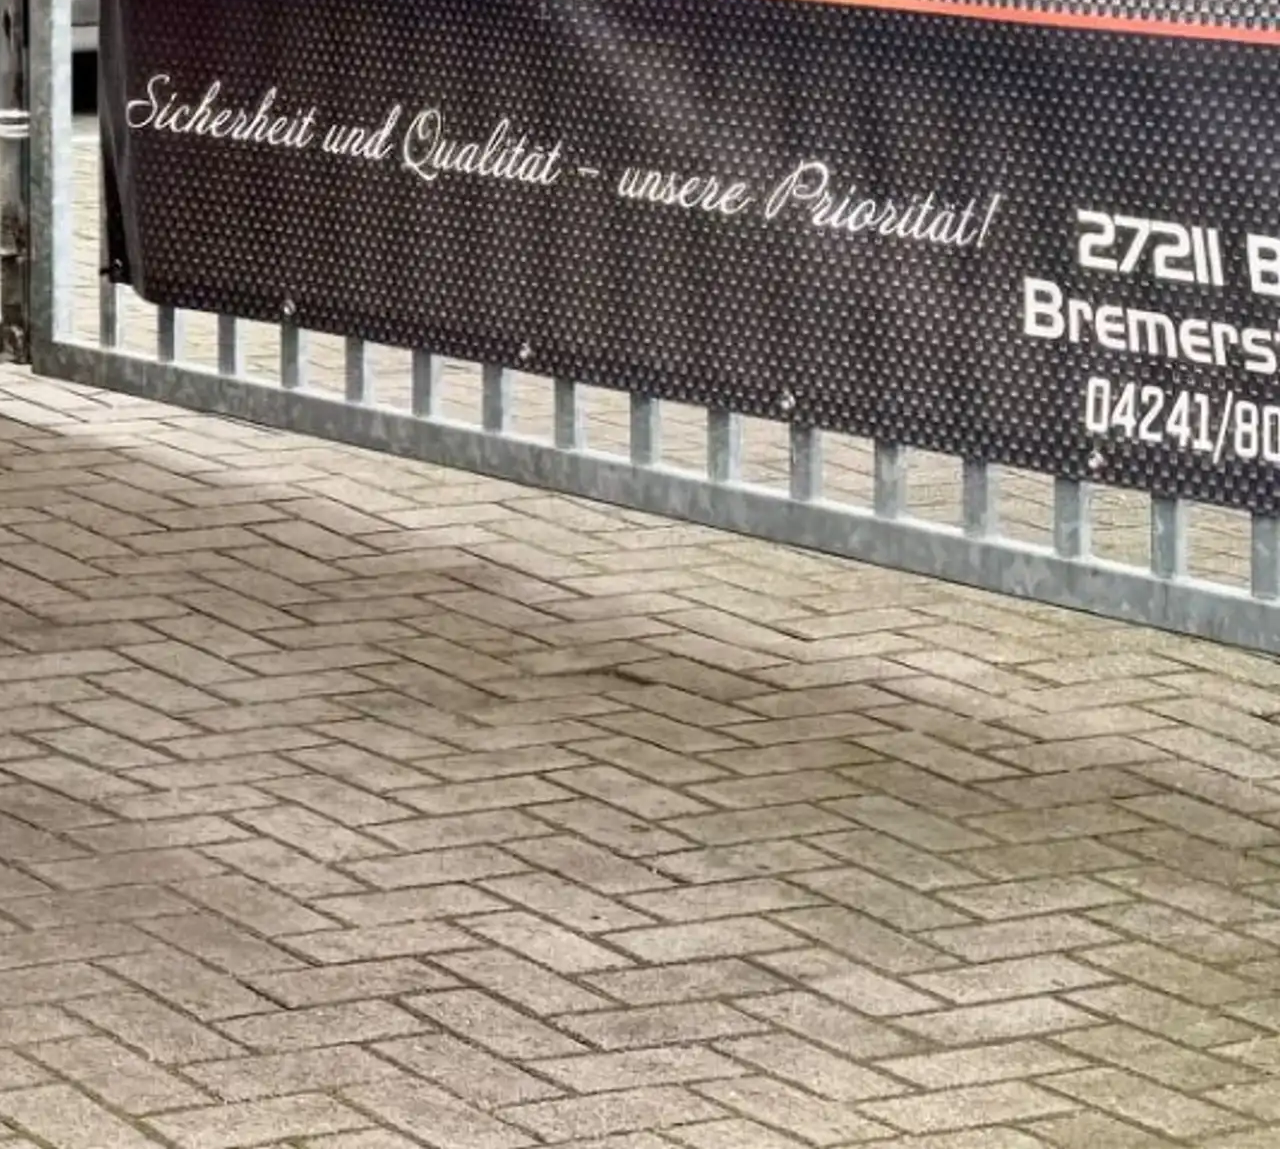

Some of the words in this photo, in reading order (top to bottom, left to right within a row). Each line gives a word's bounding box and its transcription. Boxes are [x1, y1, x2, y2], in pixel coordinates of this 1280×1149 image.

[125, 73, 317, 148] Sicherheit
[321, 104, 402, 160] und
[403, 108, 565, 185] Qualität
[618, 167, 750, 215] unsere
[765, 161, 1005, 248] Priorität!
[1077, 209, 1224, 286] 27211
[1024, 277, 1280, 375] Bremers
